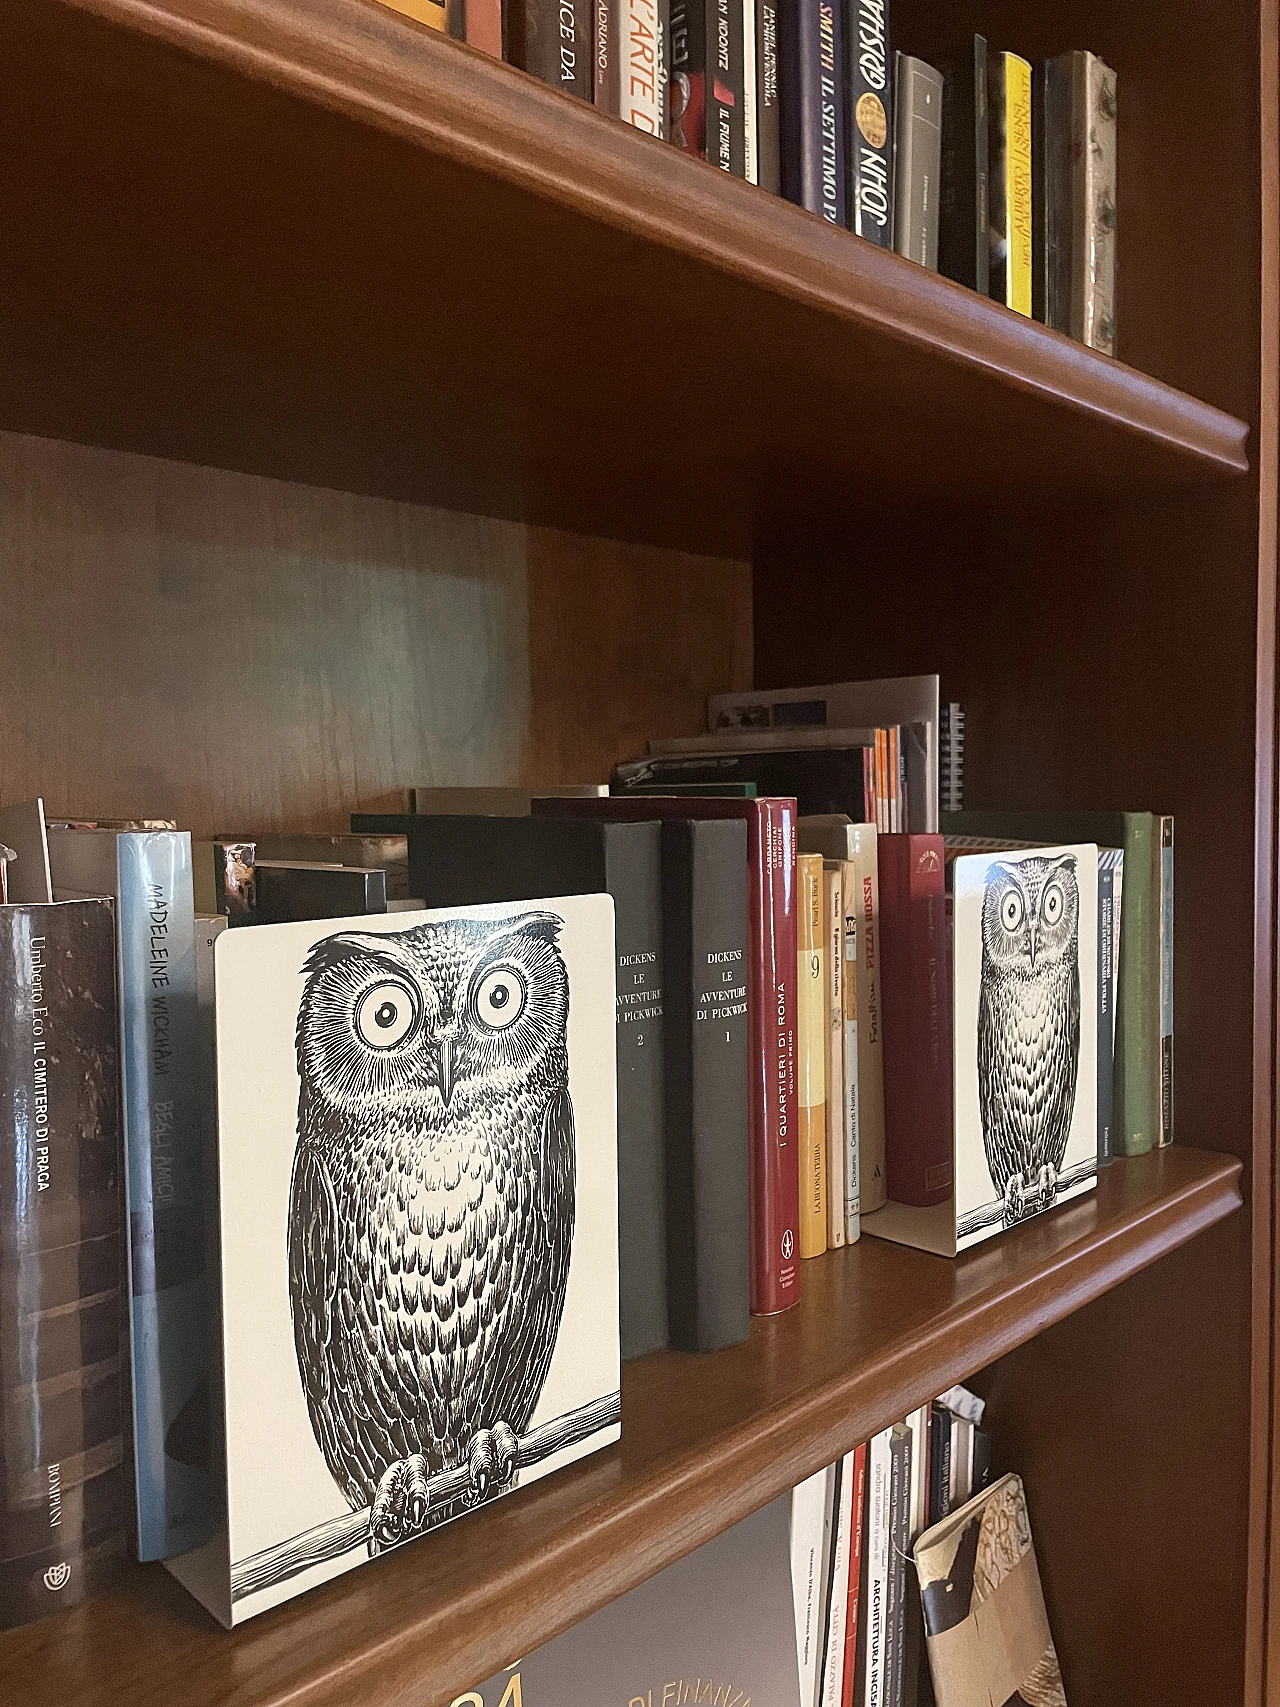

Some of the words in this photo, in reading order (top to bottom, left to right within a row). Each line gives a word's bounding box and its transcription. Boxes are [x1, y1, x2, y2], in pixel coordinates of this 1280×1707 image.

[717, 17, 729, 71] KOONTZ
[819, 2, 836, 71] SMITH
[858, 0, 887, 91] GRISHA
[559, 45, 576, 81] DA
[820, 74, 836, 96] IL
[719, 108, 730, 119] IL
[719, 121, 730, 159] FIUME
[820, 101, 837, 200] SETTIMO
[860, 147, 888, 227] JOHN
[811, 877, 819, 897] Buck
[863, 875, 873, 922] ROSSA
[811, 906, 820, 927] Pearl
[147, 884, 171, 990] MADELEINE
[864, 926, 876, 970] PIZZA
[29, 935, 46, 1002] Umberto
[619, 951, 656, 967] DICKENS
[707, 949, 742, 964] DICKENS
[633, 973, 645, 985] LE
[721, 971, 733, 982] LE
[700, 985, 747, 1003] AVVENTURE
[777, 982, 786, 1026] ROMA
[31, 1006, 49, 1037] Eco
[623, 1005, 664, 1023] PICKWICK
[696, 1010, 708, 1021] DI
[711, 1002, 748, 1020] PICKWICK
[33, 1040, 47, 1055] IL
[152, 994, 171, 1076] WICKHAM
[637, 1034, 644, 1046] 2
[725, 1031, 731, 1043] 1
[778, 1032, 786, 1048] DI
[33, 1058, 49, 1126] CIMITERO
[778, 1054, 788, 1137] QUARTIERI
[34, 1127, 49, 1142] DI
[35, 1144, 51, 1192] PRAGA
[814, 1202, 821, 1214] LA
[874, 1463, 882, 1489] sandra
[940, 1441, 950, 1483] italiano
[47, 1463, 62, 1529] BOMPIANI
[891, 1474, 899, 1502] Giovani
[902, 1465, 910, 1496] Giovani
[891, 1503, 899, 1535] Premio
[873, 1552, 880, 1560] di
[870, 1579, 881, 1666] ARCHITETTURA
[830, 1638, 837, 1652] DI
